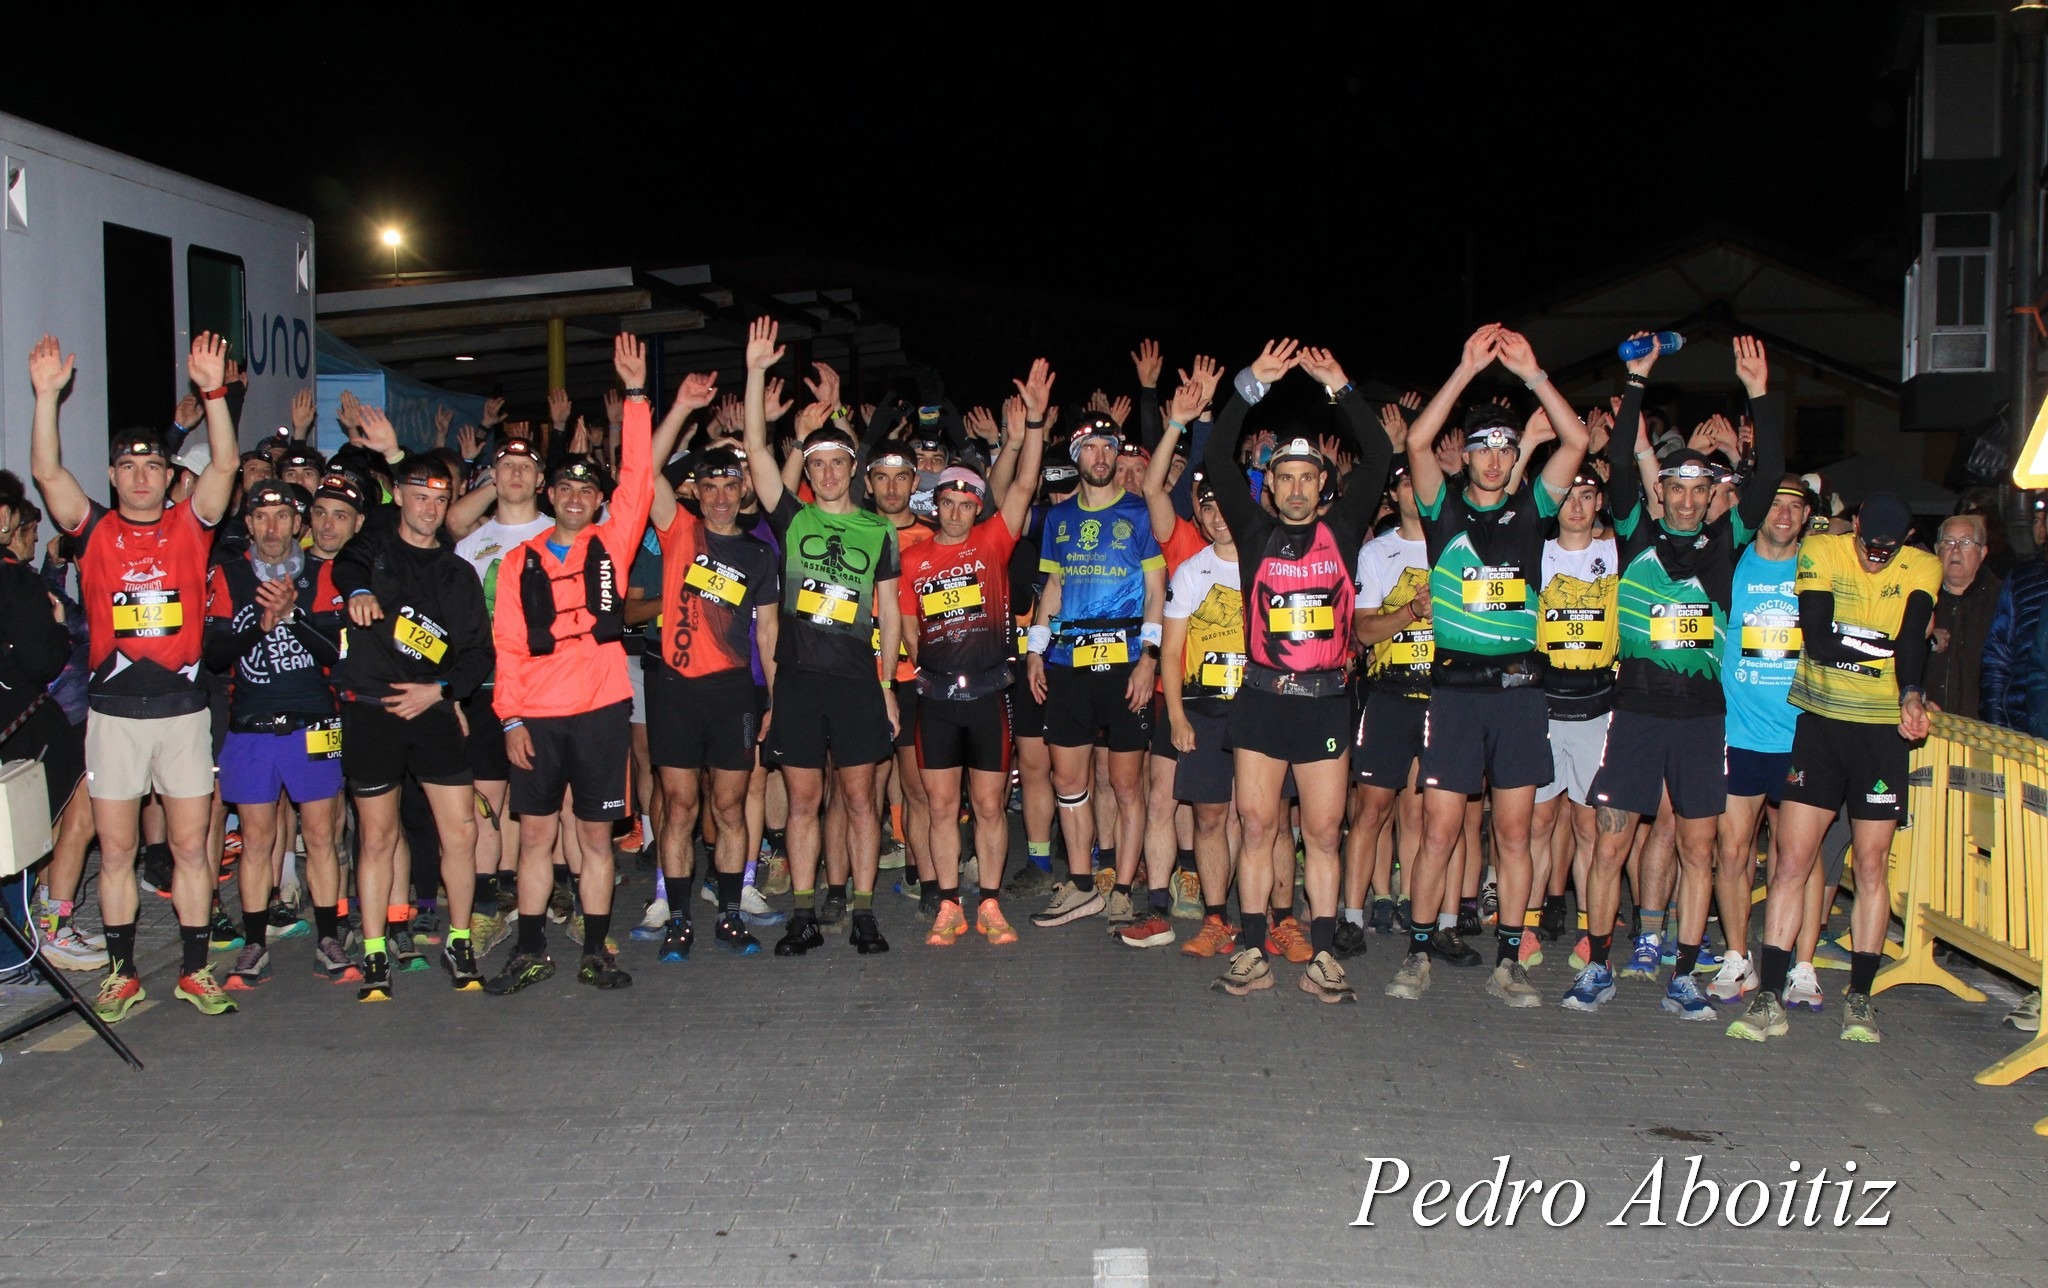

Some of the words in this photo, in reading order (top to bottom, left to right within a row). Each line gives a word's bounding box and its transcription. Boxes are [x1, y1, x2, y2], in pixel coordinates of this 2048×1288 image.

[1065, 565, 1128, 577] MAGOBLAN
[1310, 560, 1338, 575] TEAM
[600, 559, 613, 612] KIPRUN
[708, 574, 726, 591] 43
[943, 580, 967, 590] CICERO
[1486, 581, 1504, 597] 36
[820, 596, 836, 612] 79
[943, 590, 960, 606] 33
[132, 606, 163, 622] 142
[1288, 608, 1315, 624] 181
[1677, 609, 1703, 617] CICERO
[1566, 622, 1584, 636] 38
[1670, 618, 1698, 634] 156
[409, 626, 434, 649] 129
[1760, 629, 1789, 644] 176
[1091, 645, 1108, 659] 72
[1411, 643, 1429, 658] 39
[270, 654, 315, 674] TEAM
[1746, 660, 1783, 669] Recimetal
[1223, 667, 1240, 681] 41
